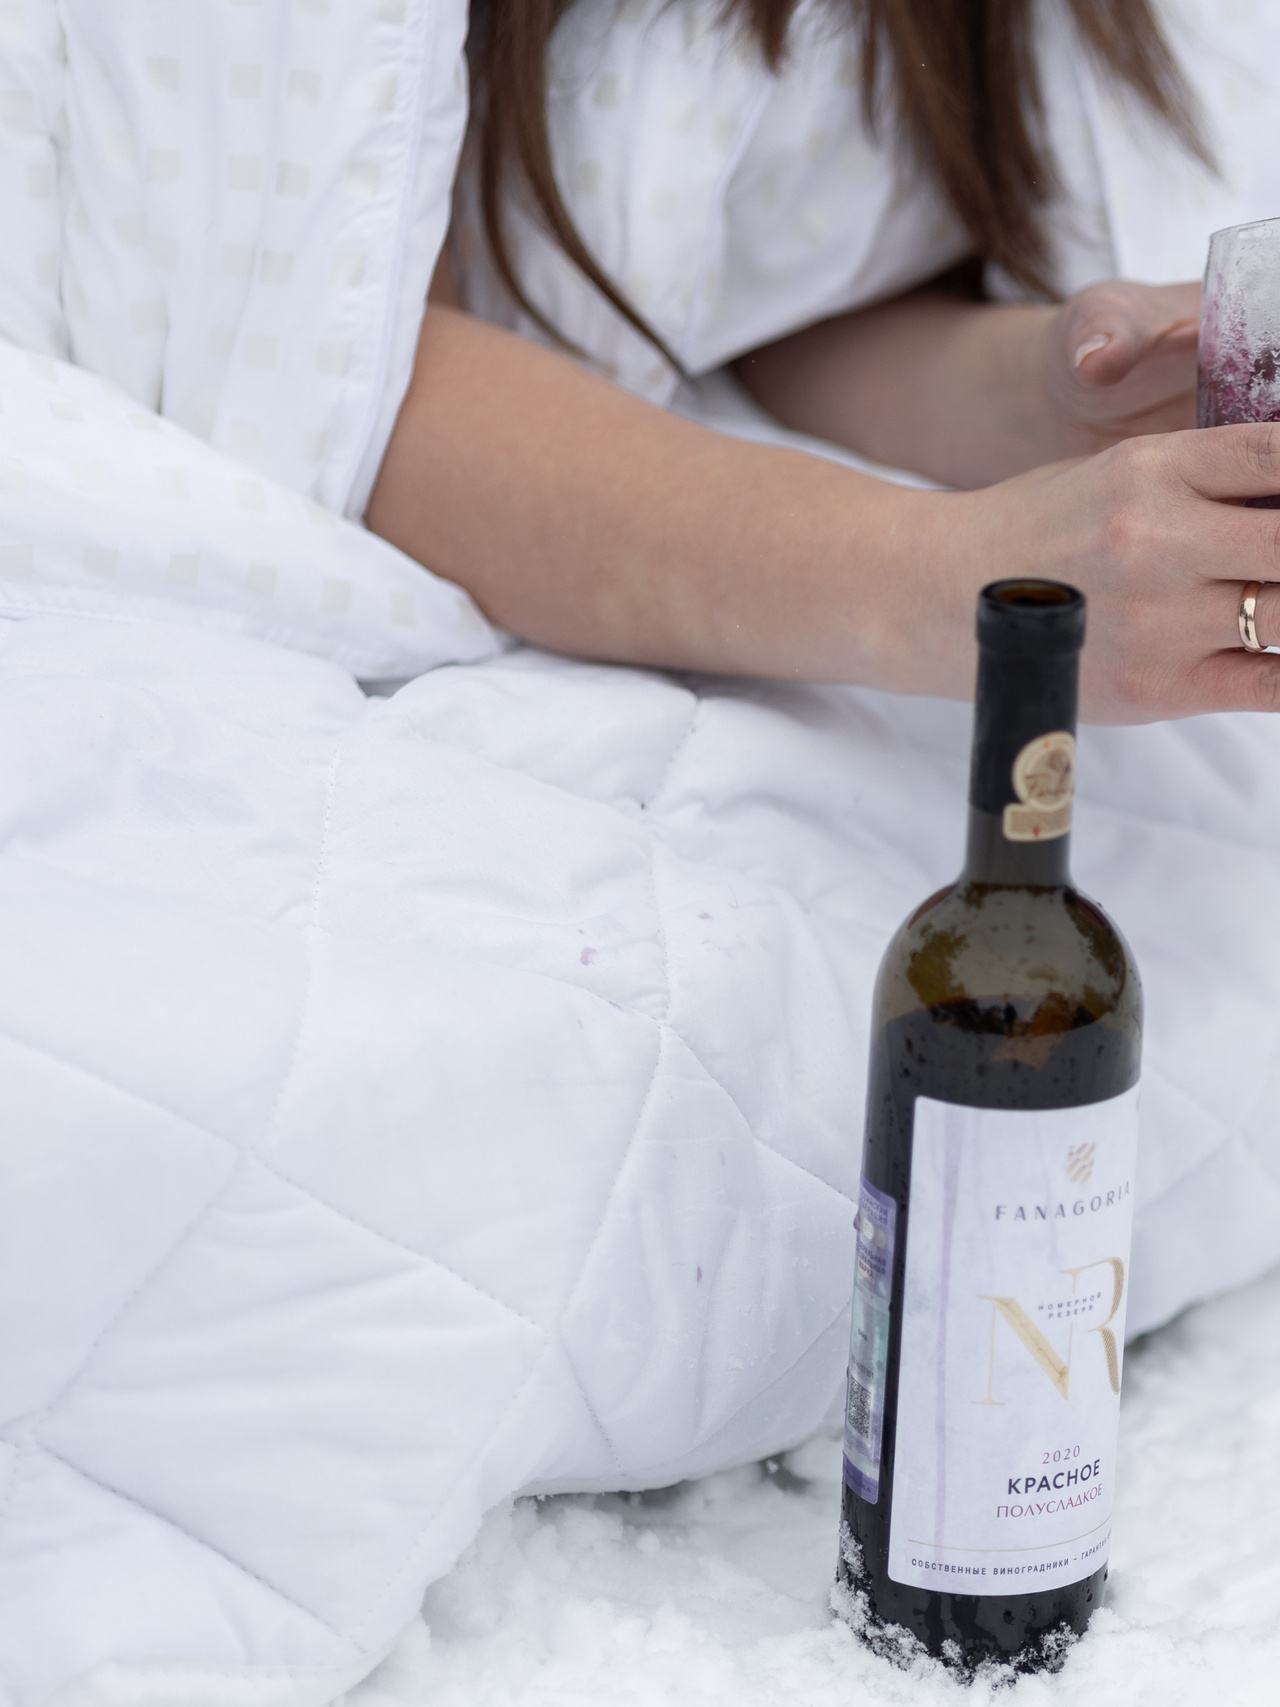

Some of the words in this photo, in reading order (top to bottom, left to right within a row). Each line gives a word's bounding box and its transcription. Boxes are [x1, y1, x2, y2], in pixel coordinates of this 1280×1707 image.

[995, 1180, 1130, 1221] FANAGORIA
[1042, 1445, 1081, 1464] 2020
[1007, 1458, 1101, 1495] КРАСНОЕ
[996, 1482, 1103, 1518] ПОЛУСЛАДКОЕ
[911, 1557, 987, 1576] СОБСТВЕННЫЕ
[993, 1557, 1069, 1576] ВИНОГРАДНИКИ
